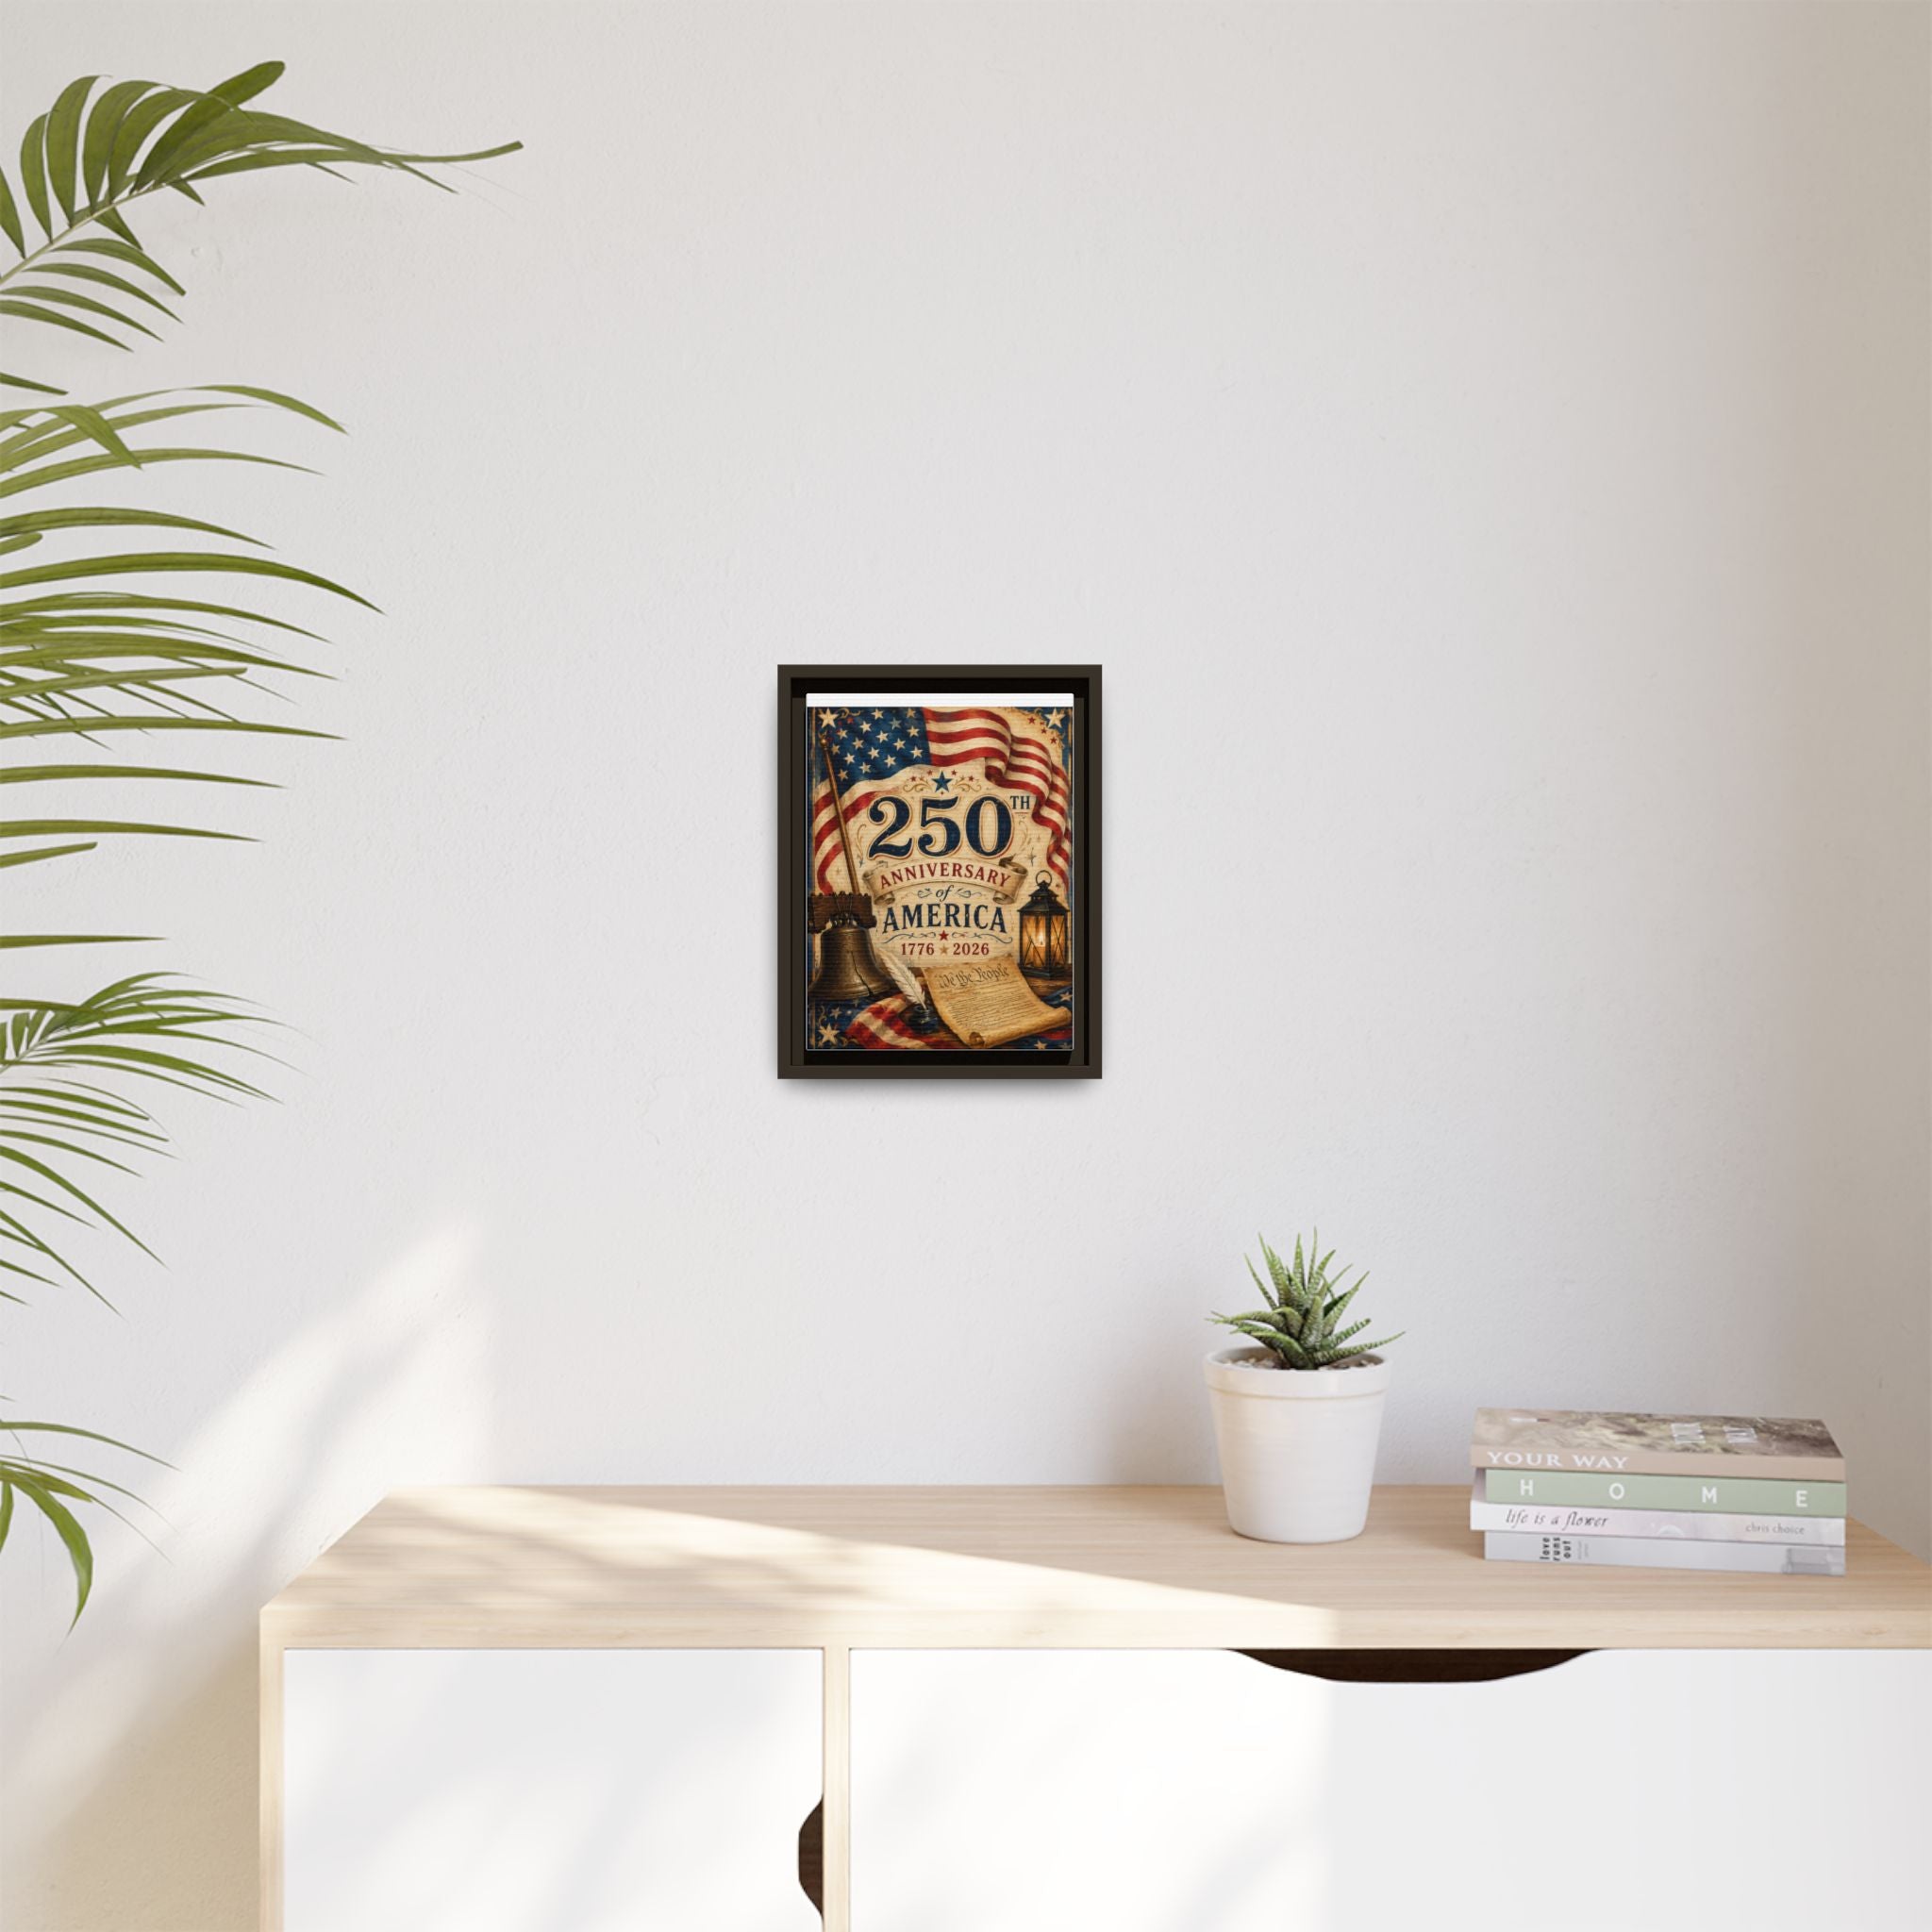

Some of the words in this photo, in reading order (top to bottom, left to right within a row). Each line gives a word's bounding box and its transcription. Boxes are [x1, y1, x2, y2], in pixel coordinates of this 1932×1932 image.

[880, 862, 1011, 890] ANNIVERSARY
[936, 885, 955, 902] of
[882, 903, 1008, 934] AMERICA
[901, 942, 935, 956] 1776
[953, 942, 990, 956] 2026
[939, 973, 955, 989] We
[955, 970, 973, 987] the
[973, 963, 1009, 983] People
[1487, 1451, 1563, 1467] YOUR
[1573, 1455, 1630, 1469] WAY
[1506, 1508, 1529, 1528] life
[1534, 1512, 1546, 1525] is
[1550, 1516, 1559, 1525] a
[1561, 1510, 1609, 1531] flower
[1772, 1522, 1806, 1536] choice
[1539, 1537, 1551, 1559] love
[1553, 1537, 1561, 1561] runs
[1562, 1541, 1572, 1558] out
